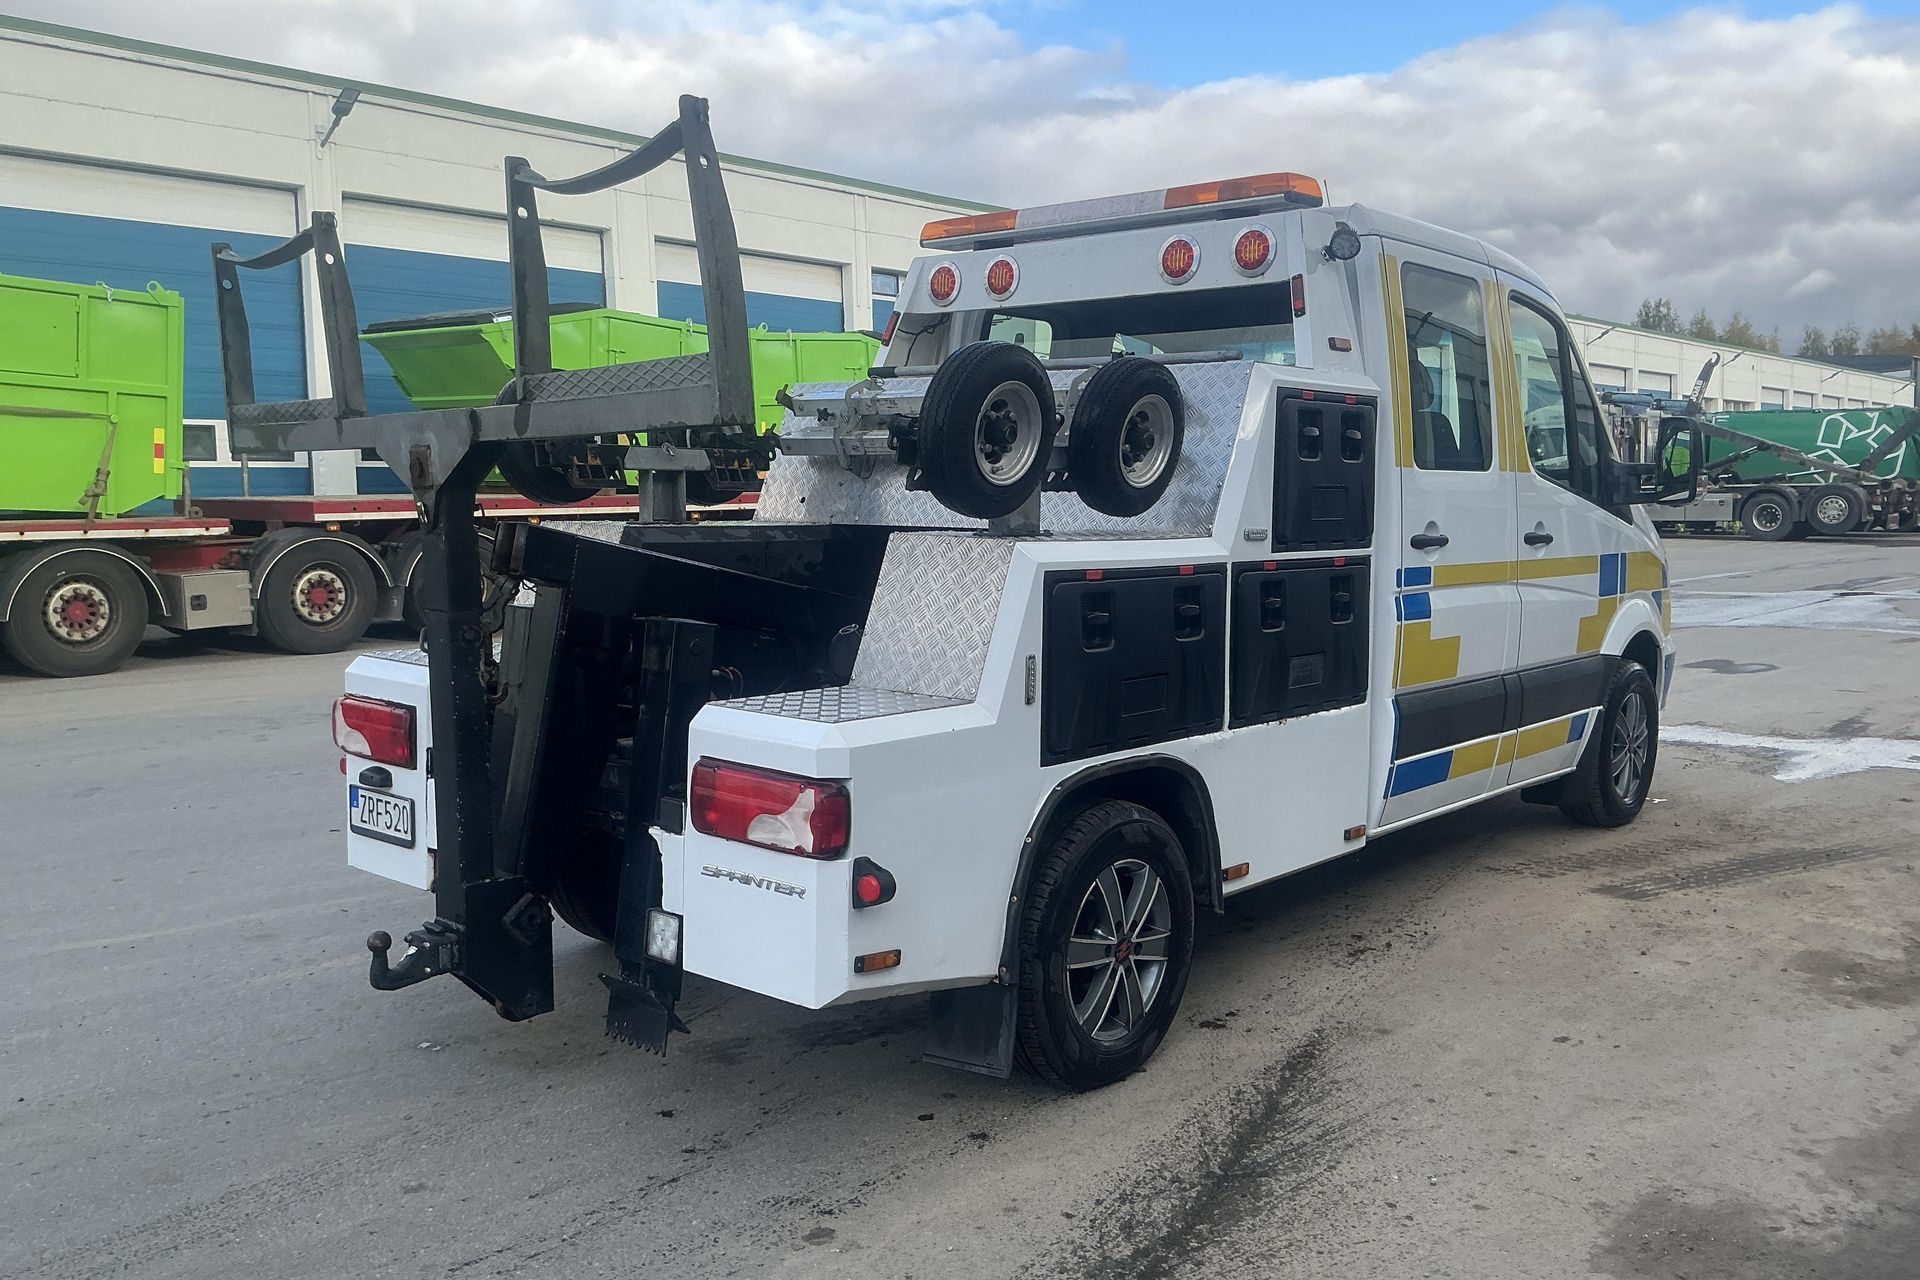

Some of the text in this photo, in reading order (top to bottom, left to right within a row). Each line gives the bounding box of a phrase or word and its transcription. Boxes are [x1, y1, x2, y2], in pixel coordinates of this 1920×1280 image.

[1690, 379, 1704, 402] JOAB
[360, 794, 409, 835] ZRF520
[701, 865, 806, 900] SPRINTER
